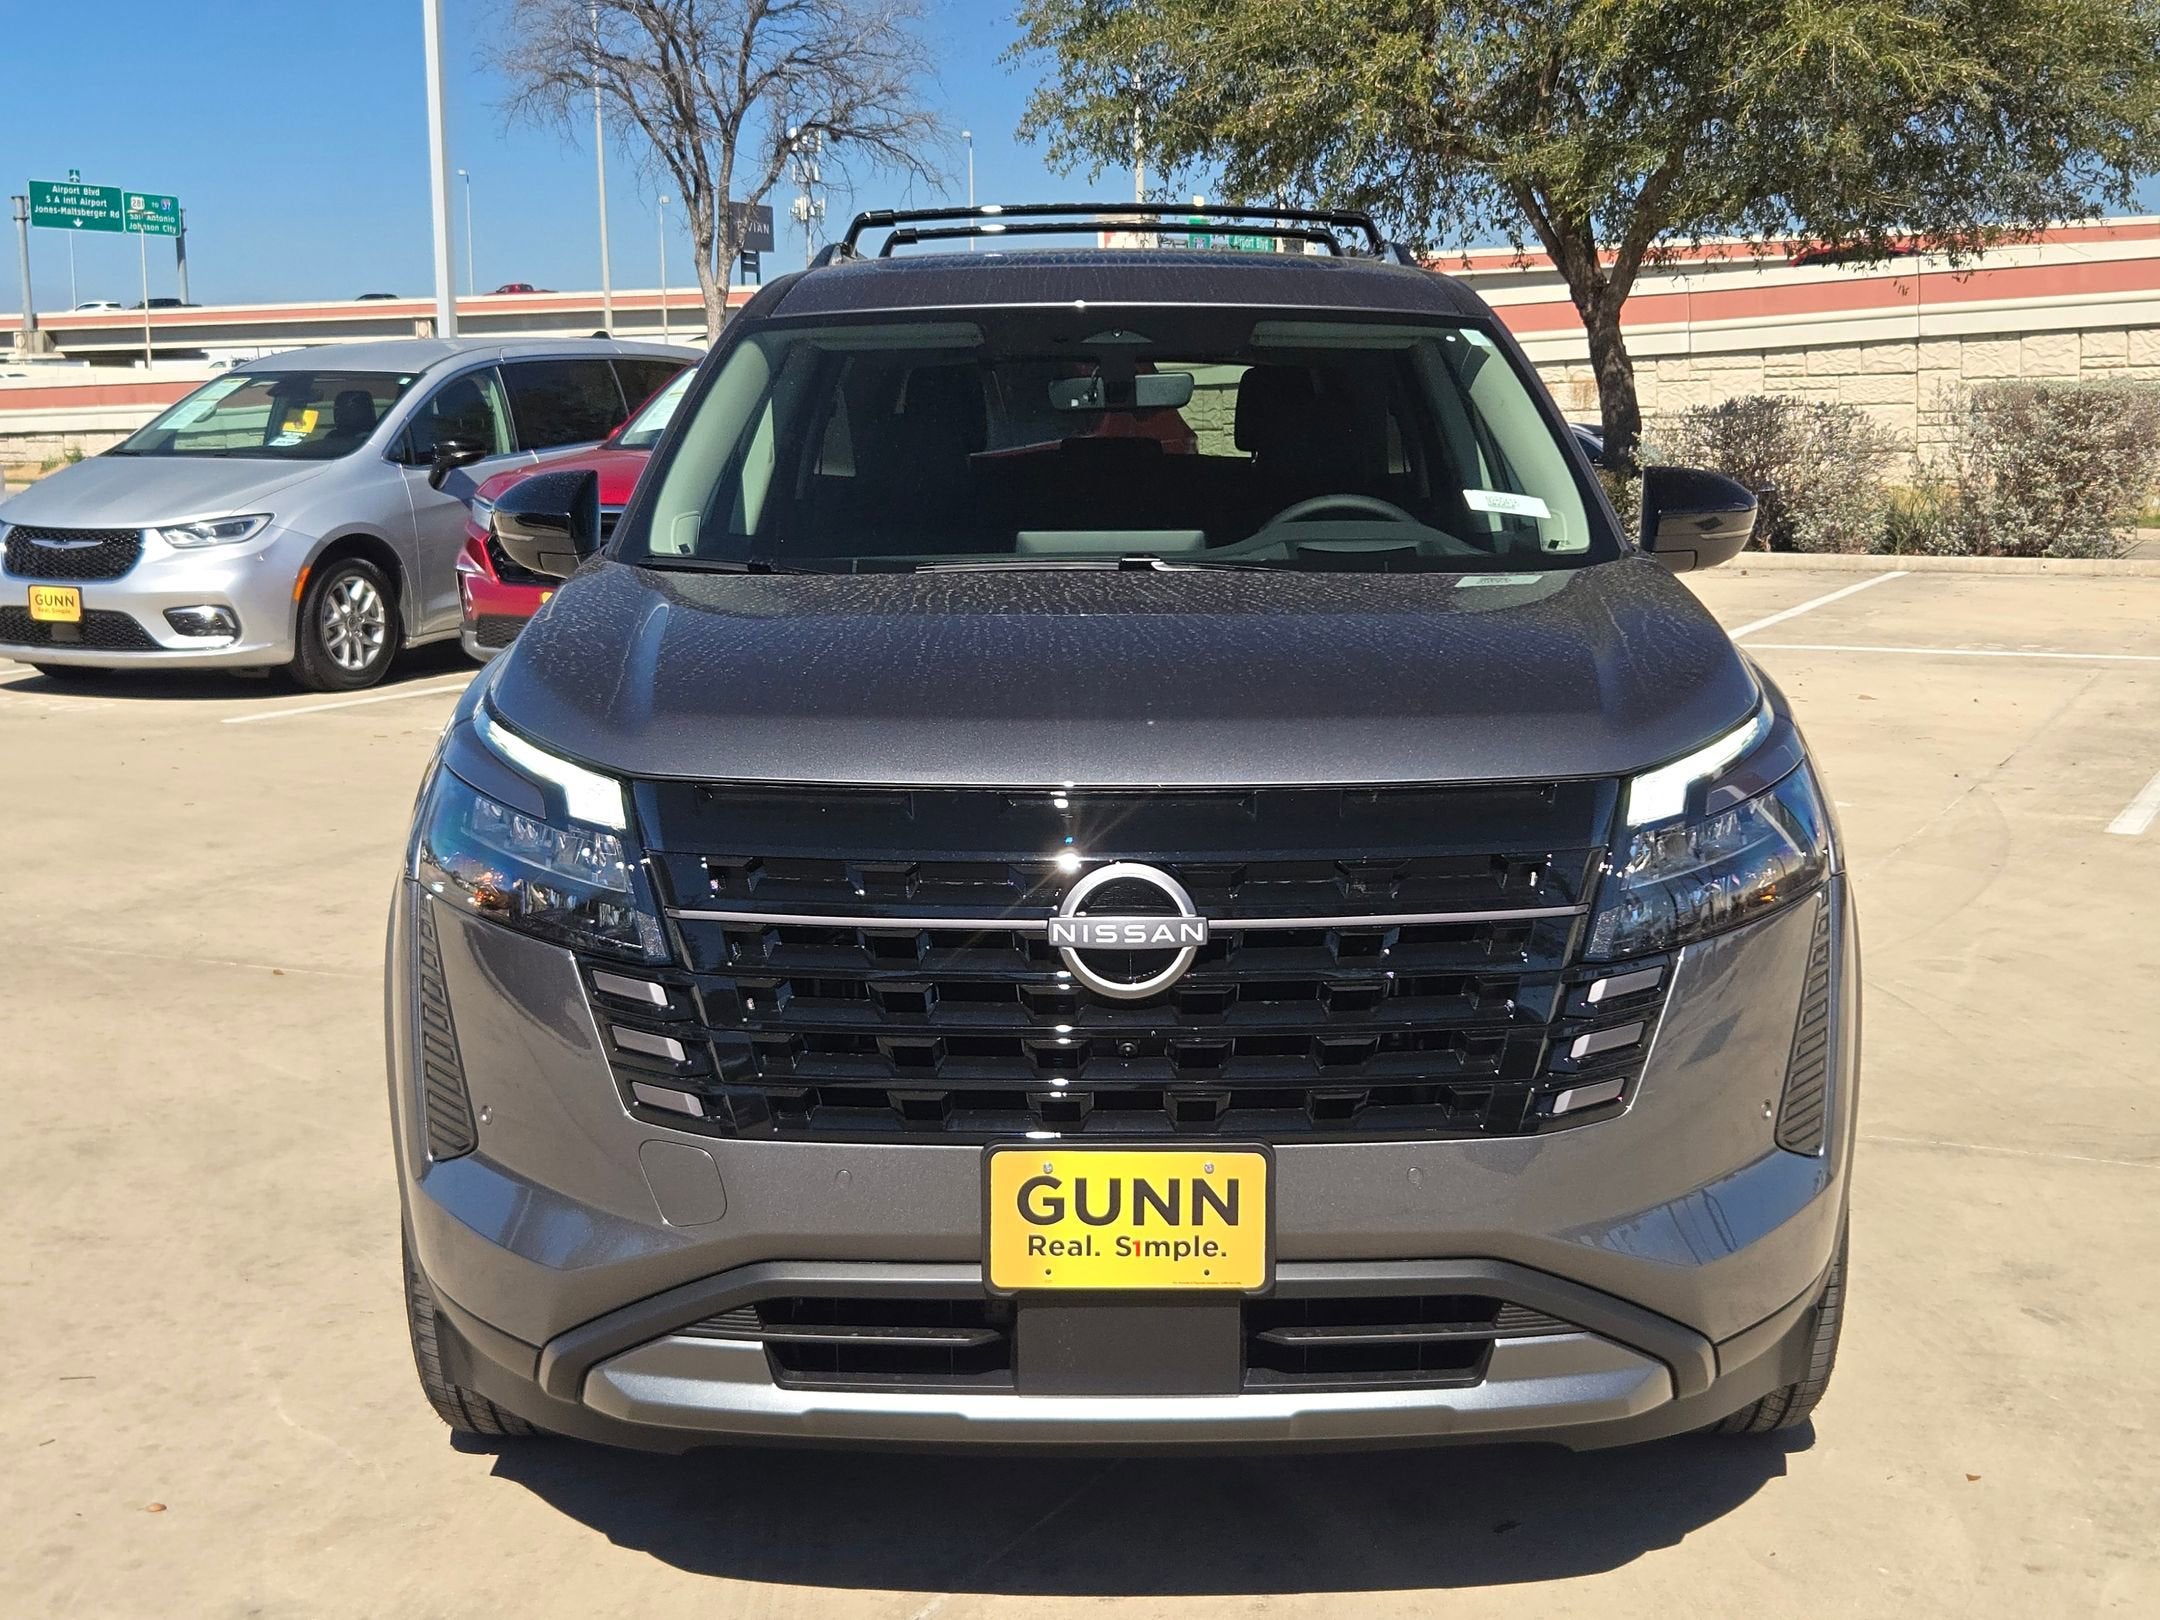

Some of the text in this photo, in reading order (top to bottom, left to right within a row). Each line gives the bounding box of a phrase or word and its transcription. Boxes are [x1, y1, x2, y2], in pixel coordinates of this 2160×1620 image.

[52, 184, 100, 196] Airport Blvd
[45, 195, 51, 203] S
[54, 195, 60, 204] A
[80, 197, 107, 208] Airport
[34, 204, 120, 219] Jones-Maltsberger Rd
[35, 593, 74, 607] GUNN
[1052, 922, 1204, 943] NISSAN
[1017, 1175, 1240, 1226] GUNN
[1028, 1235, 1101, 1257] Real.
